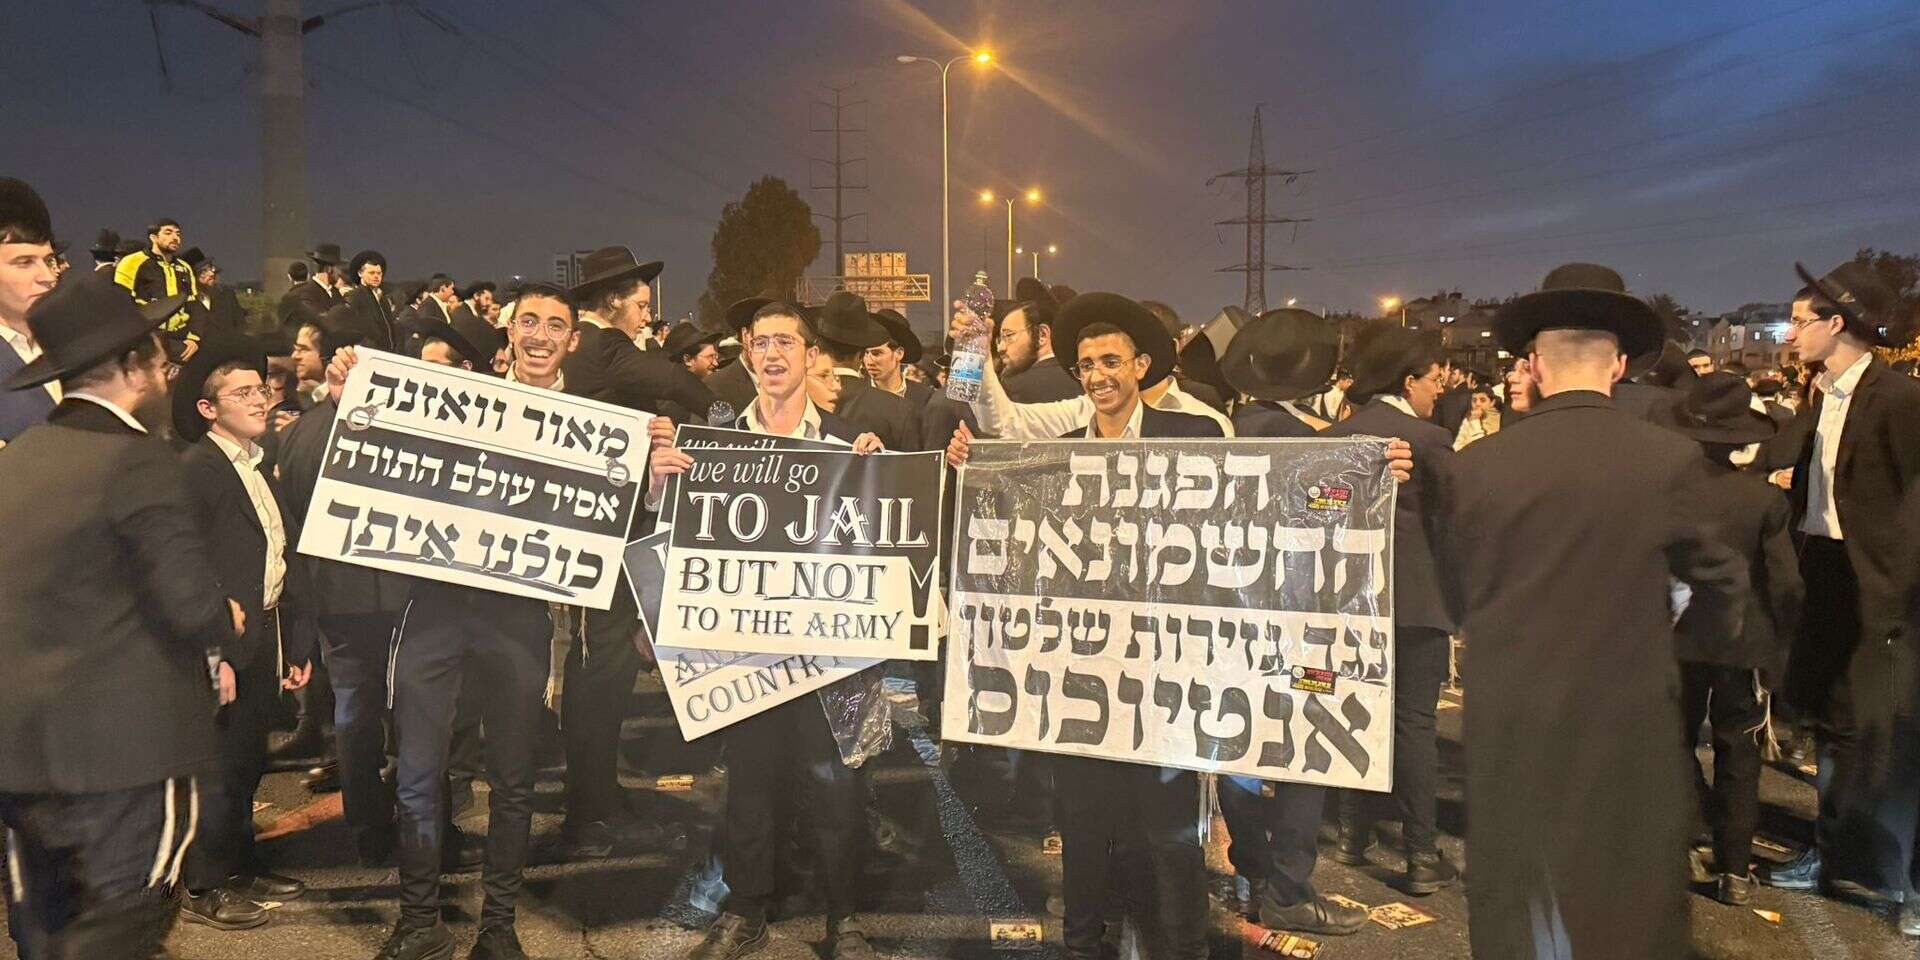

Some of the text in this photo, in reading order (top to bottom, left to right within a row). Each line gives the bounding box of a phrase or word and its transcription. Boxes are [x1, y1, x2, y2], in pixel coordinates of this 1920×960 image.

[365, 371, 630, 458] מאור וואזנה
[332, 435, 620, 522] אסיר עולם התורה
[689, 455, 819, 493] we will go
[1062, 450, 1271, 511] הפגנת
[327, 498, 461, 565] איתך
[688, 491, 929, 548] TO JAIL
[479, 529, 603, 589] כולנו
[679, 556, 777, 596] BUT
[791, 560, 888, 601] NOT
[967, 513, 1386, 595] החשמונאים
[678, 605, 904, 641] TO THE ARMY
[959, 597, 1112, 662] שלטון
[1124, 611, 1285, 676] גזירות
[1302, 621, 1388, 682] נגד
[967, 660, 1372, 779] אנטיוכוס
